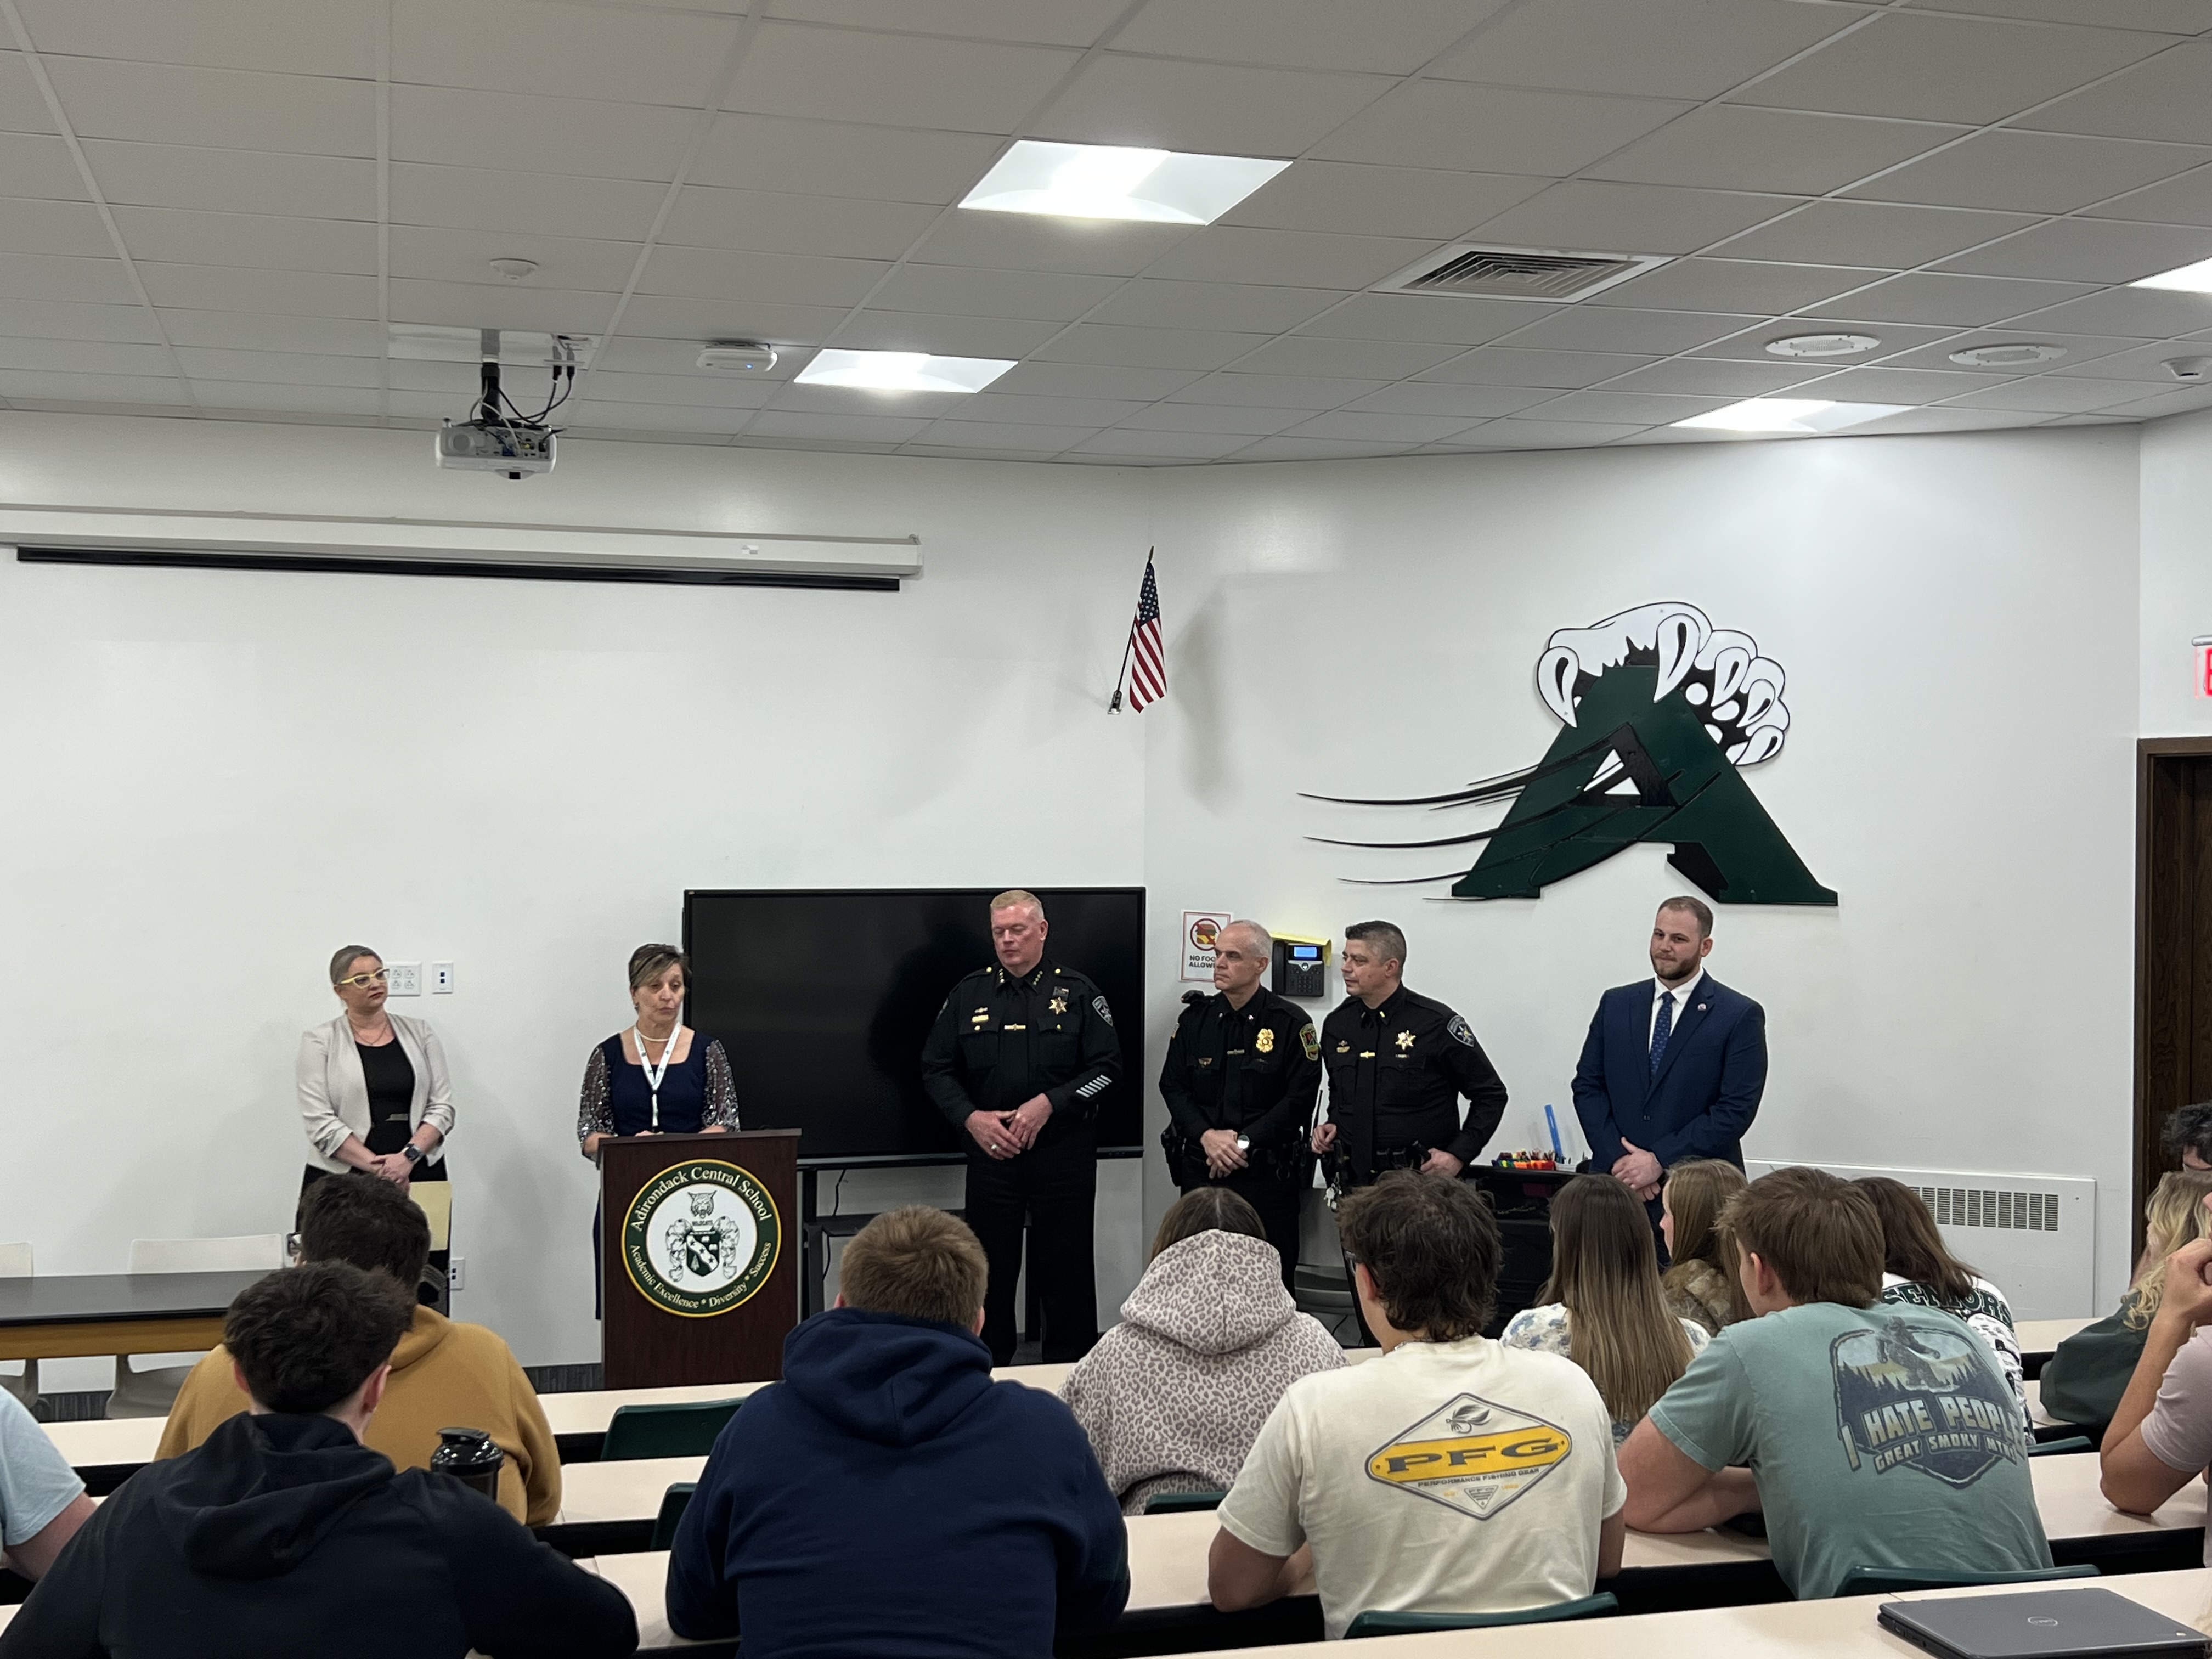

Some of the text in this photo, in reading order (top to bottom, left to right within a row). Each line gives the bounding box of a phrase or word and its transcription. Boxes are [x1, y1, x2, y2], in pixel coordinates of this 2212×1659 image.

[630, 1167, 772, 1232] Adirondack Central School
[630, 1242, 772, 1309] Academic Excellence Diversity Success
[1385, 1437, 1559, 1474] PFG
[1841, 1396, 2025, 1471] I HATE PEOPLE
[1875, 1440, 1921, 1472] GREAT
[1929, 1434, 1979, 1452] SMOKY
[1418, 1475, 1481, 1487] PERFORMANCE
[1483, 1470, 1516, 1481] FISHING
